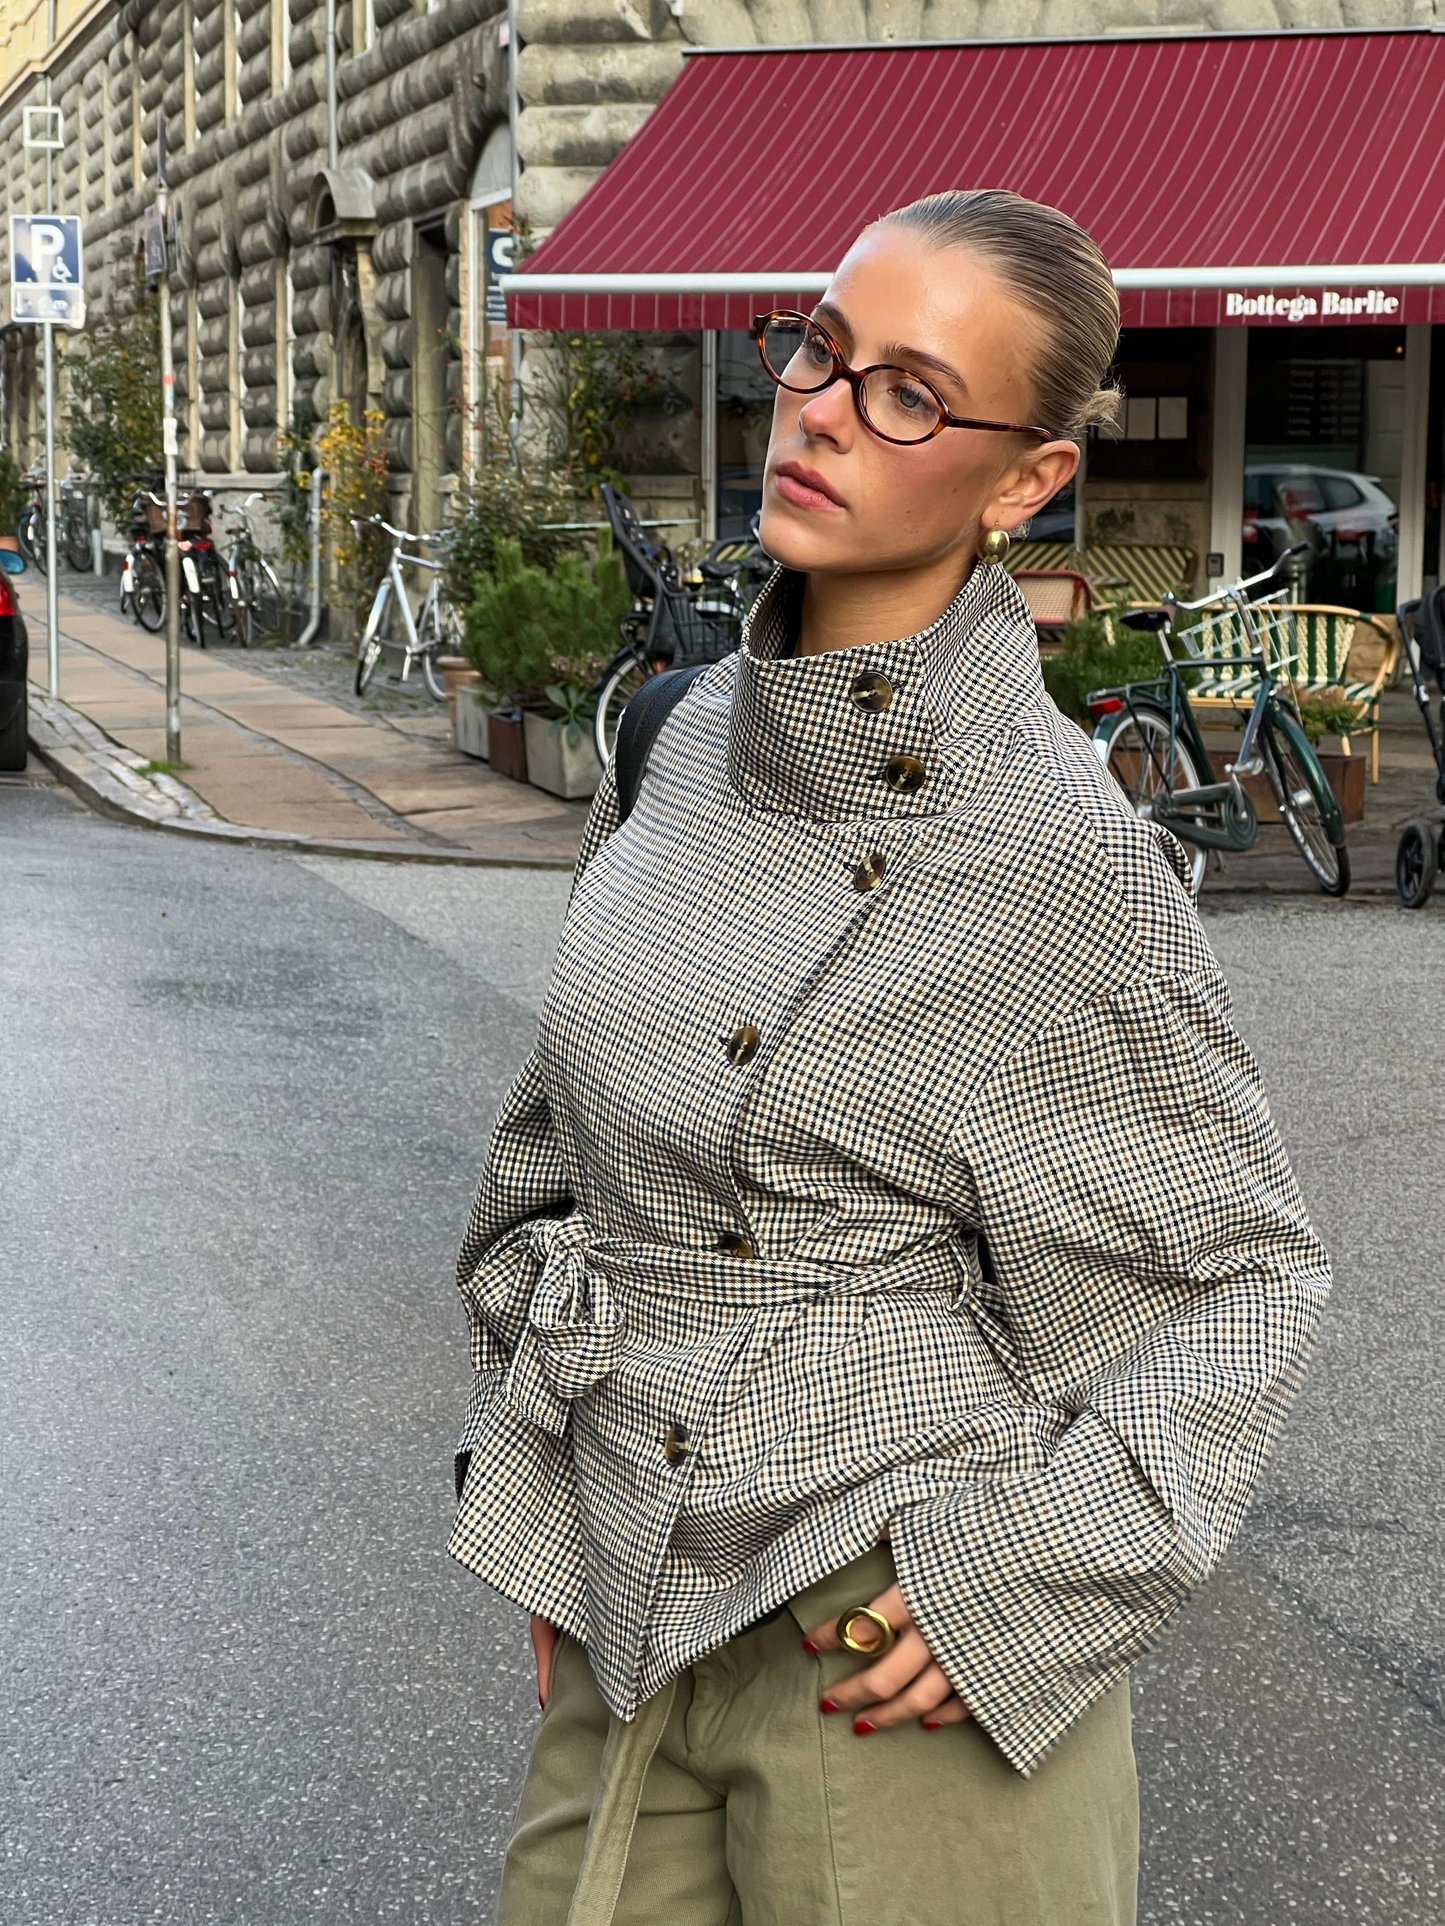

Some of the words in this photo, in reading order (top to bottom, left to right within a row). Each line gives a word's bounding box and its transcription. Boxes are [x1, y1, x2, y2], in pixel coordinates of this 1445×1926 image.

[31, 224, 65, 273] P
[1226, 293, 1317, 322] Bottega
[1322, 290, 1399, 314] Barlie
